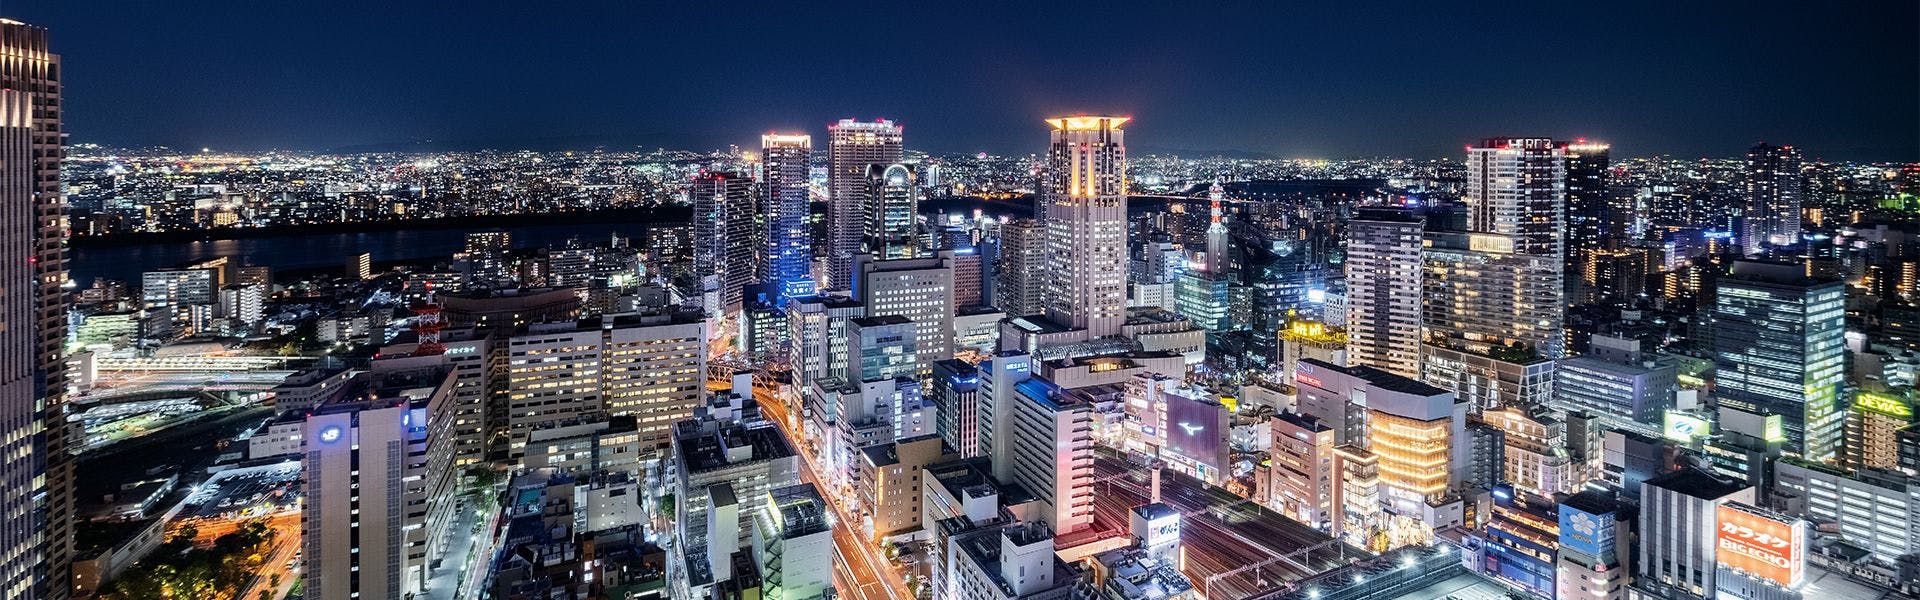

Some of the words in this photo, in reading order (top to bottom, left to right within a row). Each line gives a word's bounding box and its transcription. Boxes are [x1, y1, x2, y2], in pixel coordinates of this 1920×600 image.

[1858, 395, 1911, 416] DEVIAS
[1571, 533, 1594, 545] NOVA
[1720, 521, 1791, 548] カラオケ
[1719, 537, 1748, 554] BIG
[1748, 547, 1791, 569] ECHO
